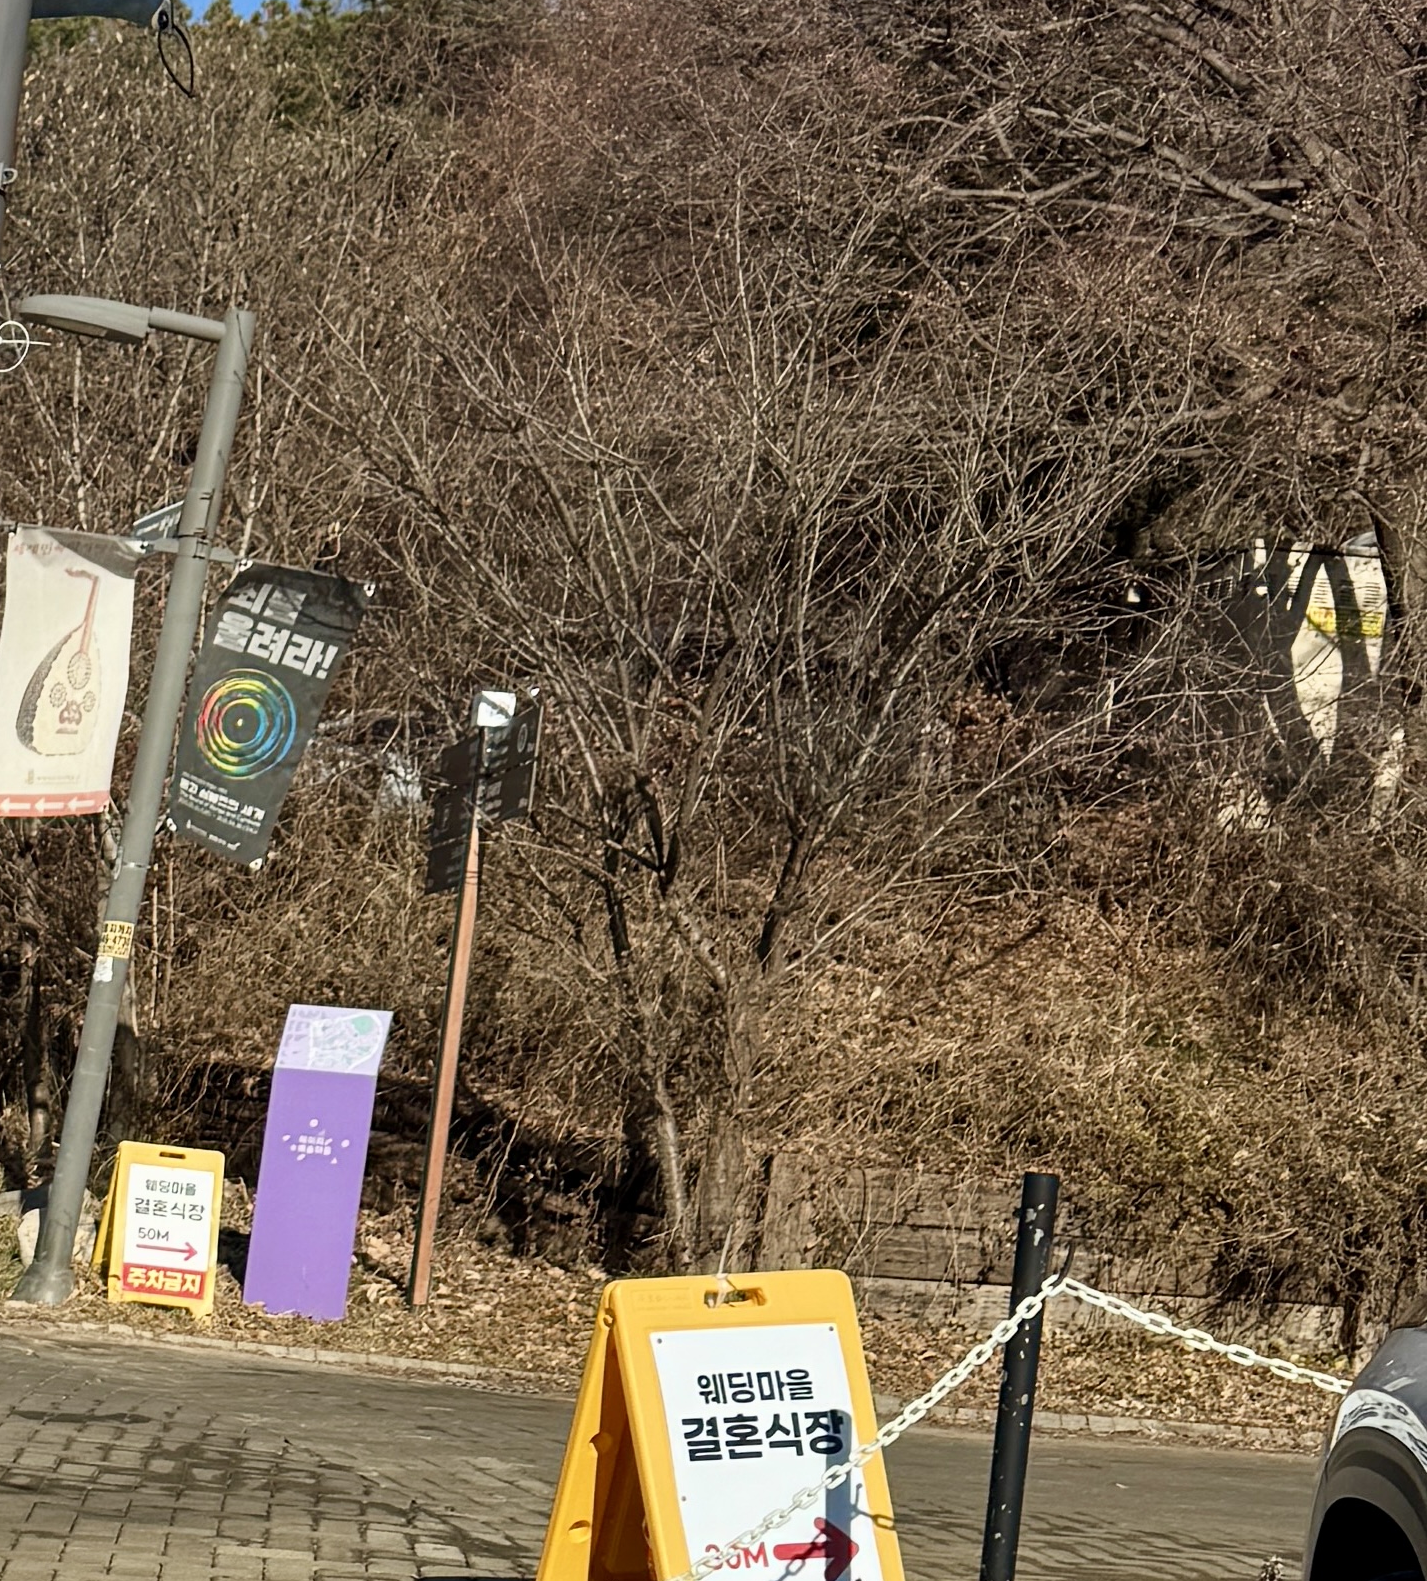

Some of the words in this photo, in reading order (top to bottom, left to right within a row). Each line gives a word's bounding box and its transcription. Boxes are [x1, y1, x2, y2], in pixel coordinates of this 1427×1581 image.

[213, 611, 339, 680] 울려라!
[145, 1179, 197, 1196] 웨딩마을
[135, 1197, 205, 1221] 결혼식장
[138, 1227, 170, 1242] 50M
[127, 1267, 202, 1294] 주차금지
[696, 1368, 814, 1405] 웨딩마을
[681, 1410, 844, 1462] 결혼식장
